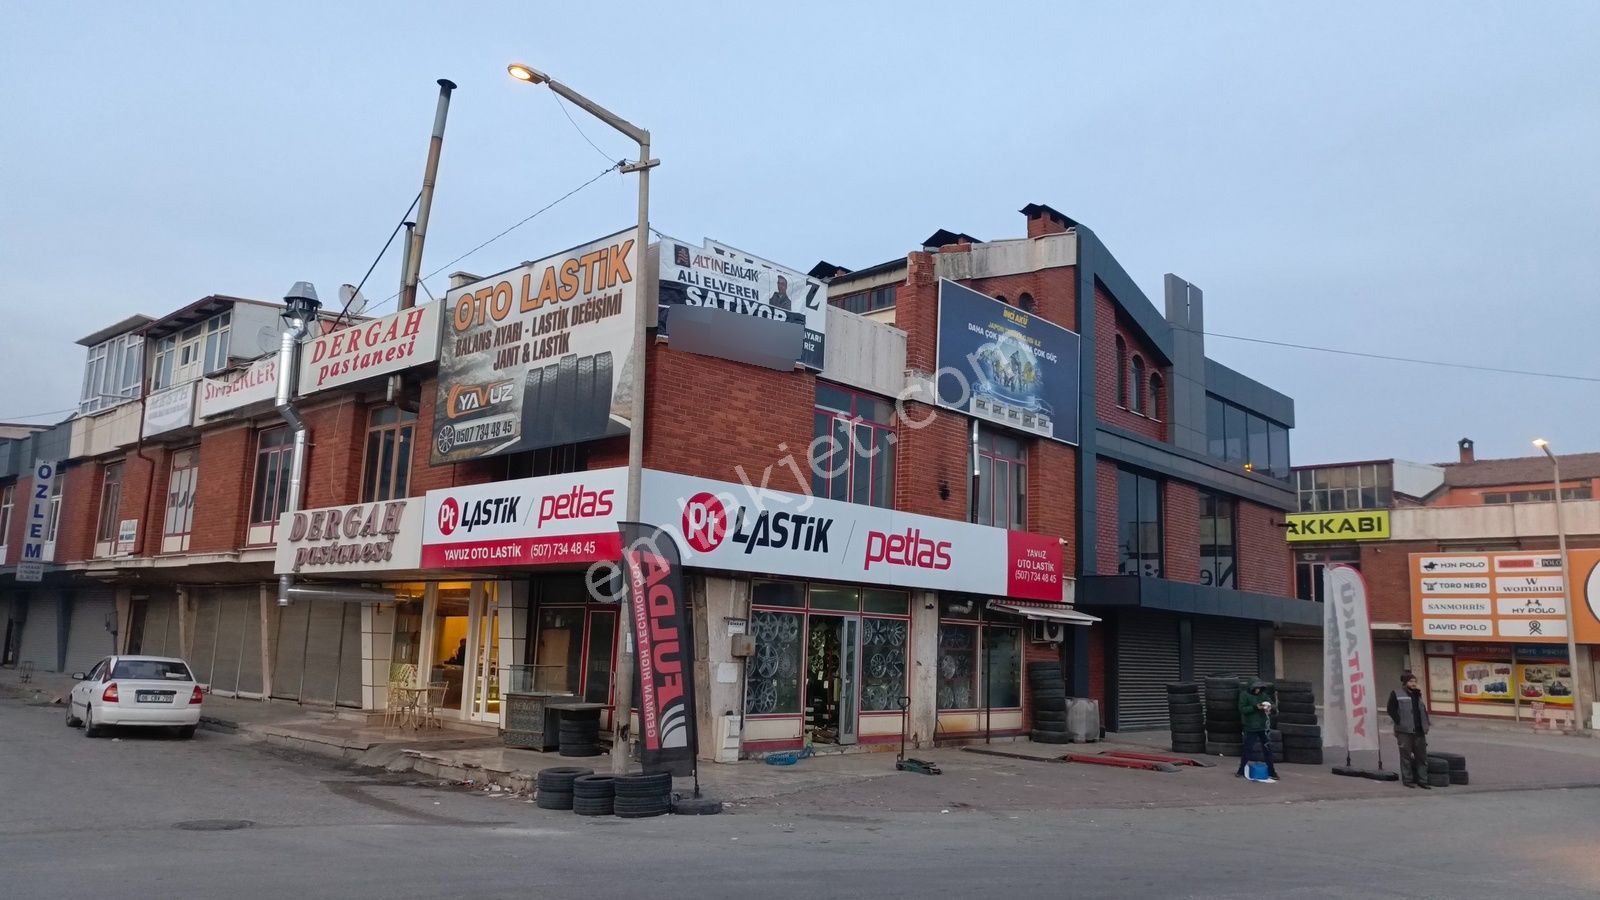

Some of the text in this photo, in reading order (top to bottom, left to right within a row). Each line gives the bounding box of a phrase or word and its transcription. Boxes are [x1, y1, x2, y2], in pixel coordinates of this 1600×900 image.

[677, 269, 759, 301] ALİ ELVEREN
[453, 281, 513, 332] OTO
[455, 331, 491, 358] BALANS
[493, 321, 522, 347] AYARI
[532, 306, 569, 337] LASTİK
[571, 289, 623, 327] DEĞİŞİMİ
[311, 307, 425, 364] DERGAH
[493, 331, 571, 371] JANT & LASTİK
[317, 334, 416, 386] pastanesi
[460, 384, 514, 411] YAVUZ
[456, 420, 513, 443] 0507 734 48 45
[24, 460, 52, 559] ÖZLEM
[288, 501, 408, 542] DERGAH
[537, 484, 614, 529] petlas
[292, 532, 395, 573] pastanesi
[444, 541, 596, 561] YAVUZ OTO LASTİK (507) 734 48 45
[864, 528, 951, 571] petlas
[1017, 559, 1031, 569] OTO
[1026, 548, 1047, 559] YAVUZ
[1015, 570, 1057, 584] (507) 734 48 45
